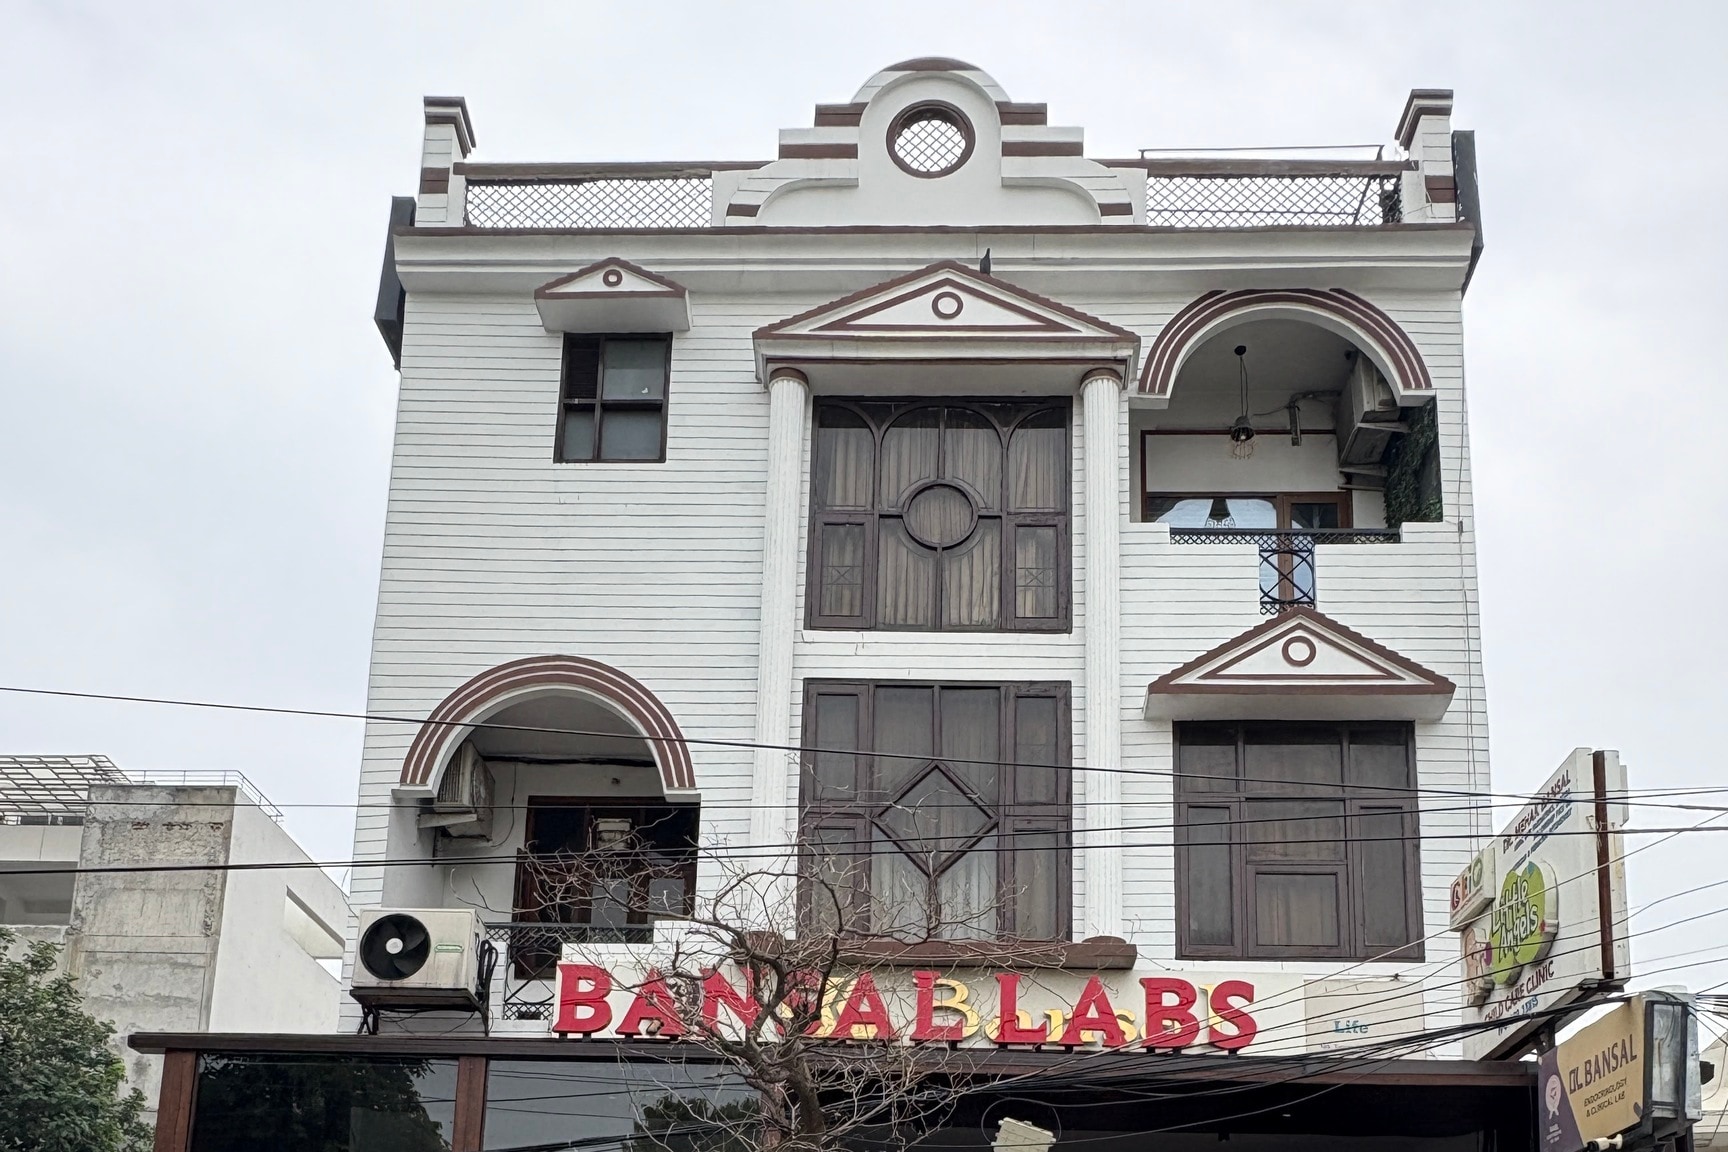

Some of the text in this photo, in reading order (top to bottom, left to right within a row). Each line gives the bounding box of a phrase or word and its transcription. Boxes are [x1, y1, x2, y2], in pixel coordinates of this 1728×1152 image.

[1492, 876, 1529, 938] Little
[1498, 903, 1538, 963] Angels
[1527, 960, 1555, 995] CLINIC
[992, 972, 1257, 1050] LABS
[1584, 1033, 1638, 1087] BANSAL
